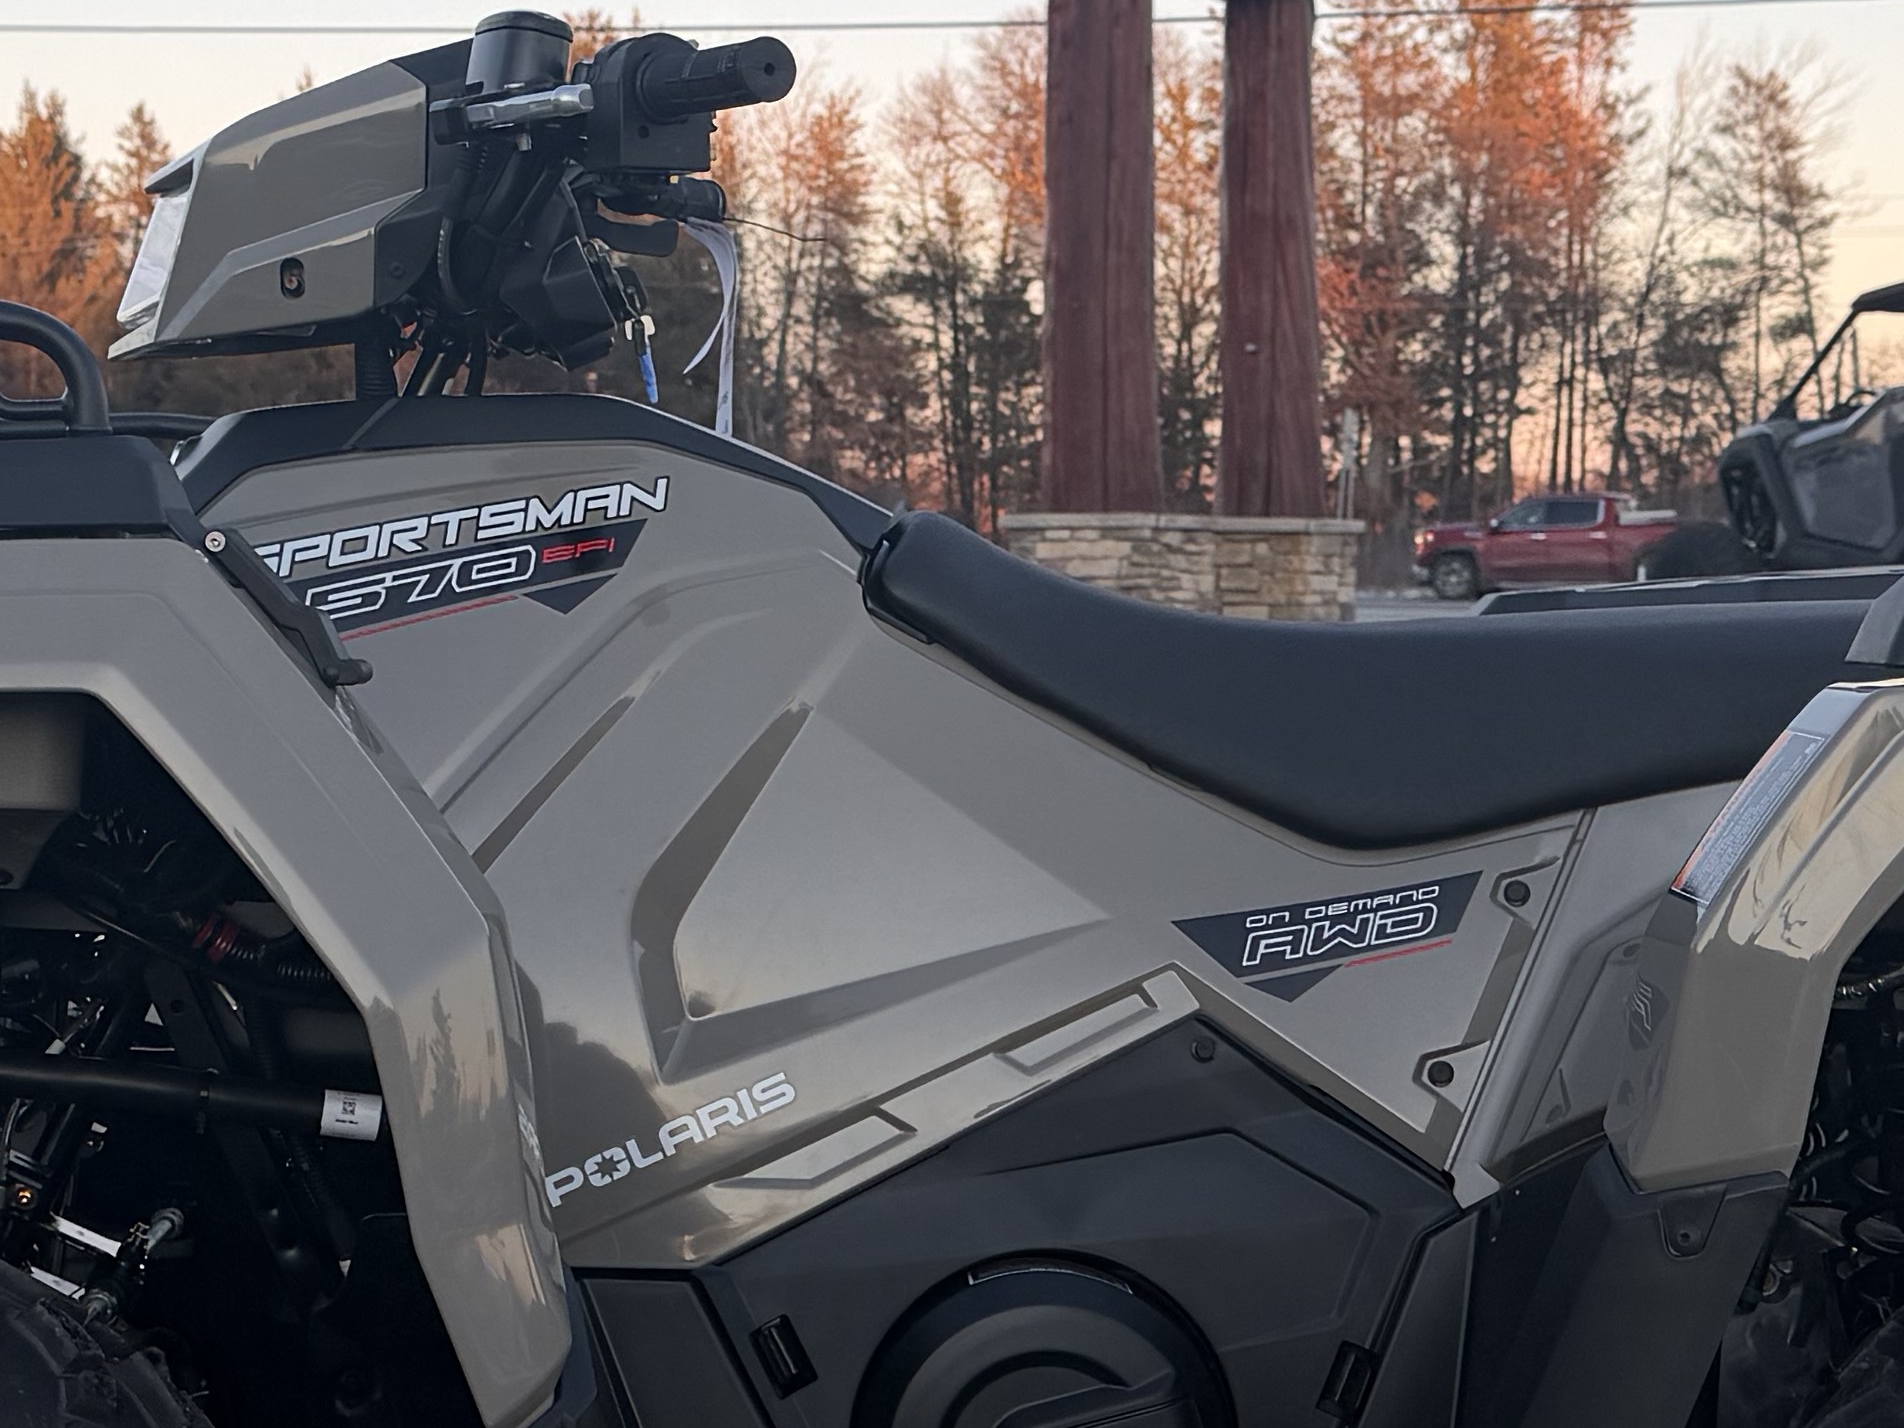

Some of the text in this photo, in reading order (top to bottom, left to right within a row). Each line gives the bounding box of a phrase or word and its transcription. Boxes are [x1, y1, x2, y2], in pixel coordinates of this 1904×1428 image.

[253, 476, 671, 579] SPORTSMAN
[305, 536, 616, 621] 570 EFI
[1242, 902, 1438, 967] AWD
[1244, 885, 1440, 930] ON DEMAND
[543, 1071, 798, 1211] POLARIS
